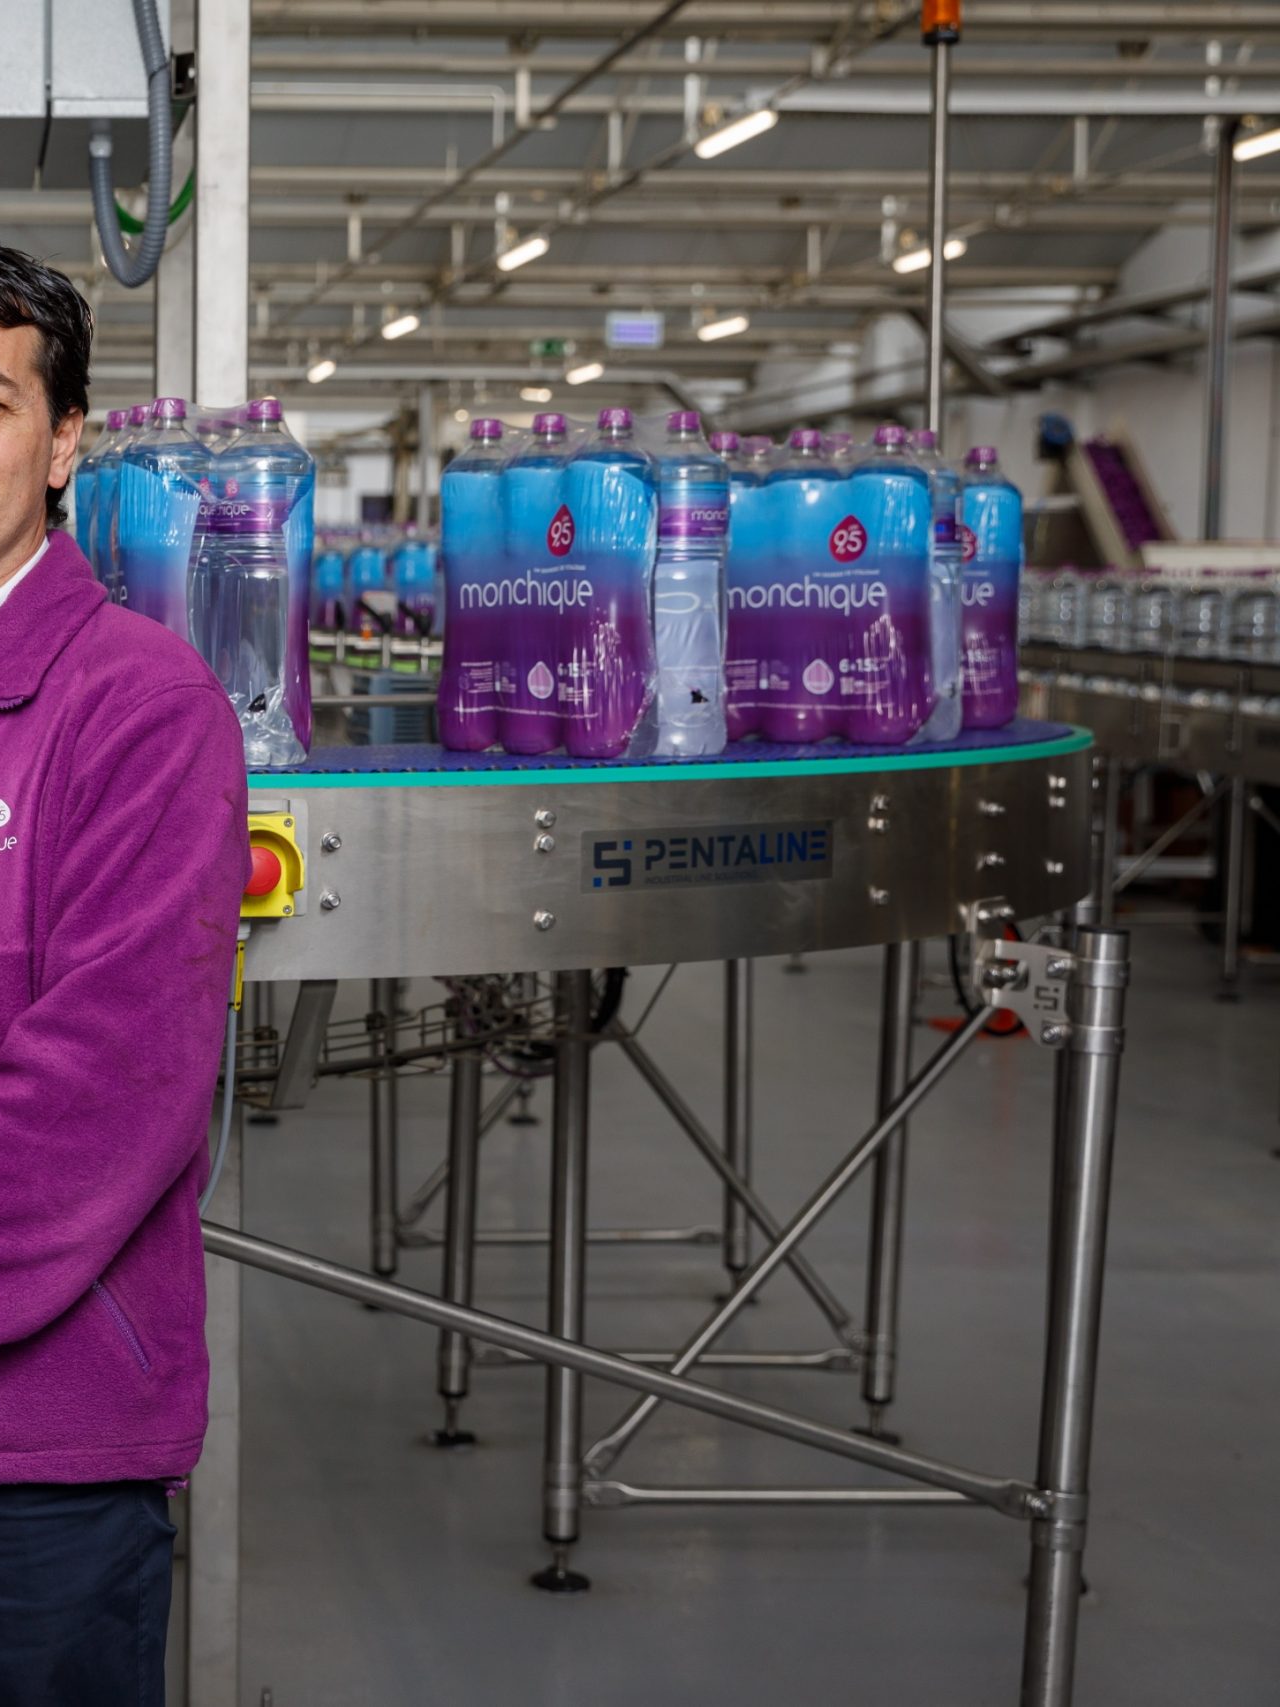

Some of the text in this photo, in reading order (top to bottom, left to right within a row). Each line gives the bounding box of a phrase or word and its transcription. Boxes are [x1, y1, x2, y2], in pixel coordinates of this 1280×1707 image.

[460, 569, 594, 615] monchique
[726, 575, 887, 616] monchique
[645, 830, 827, 871] PENTALINE
